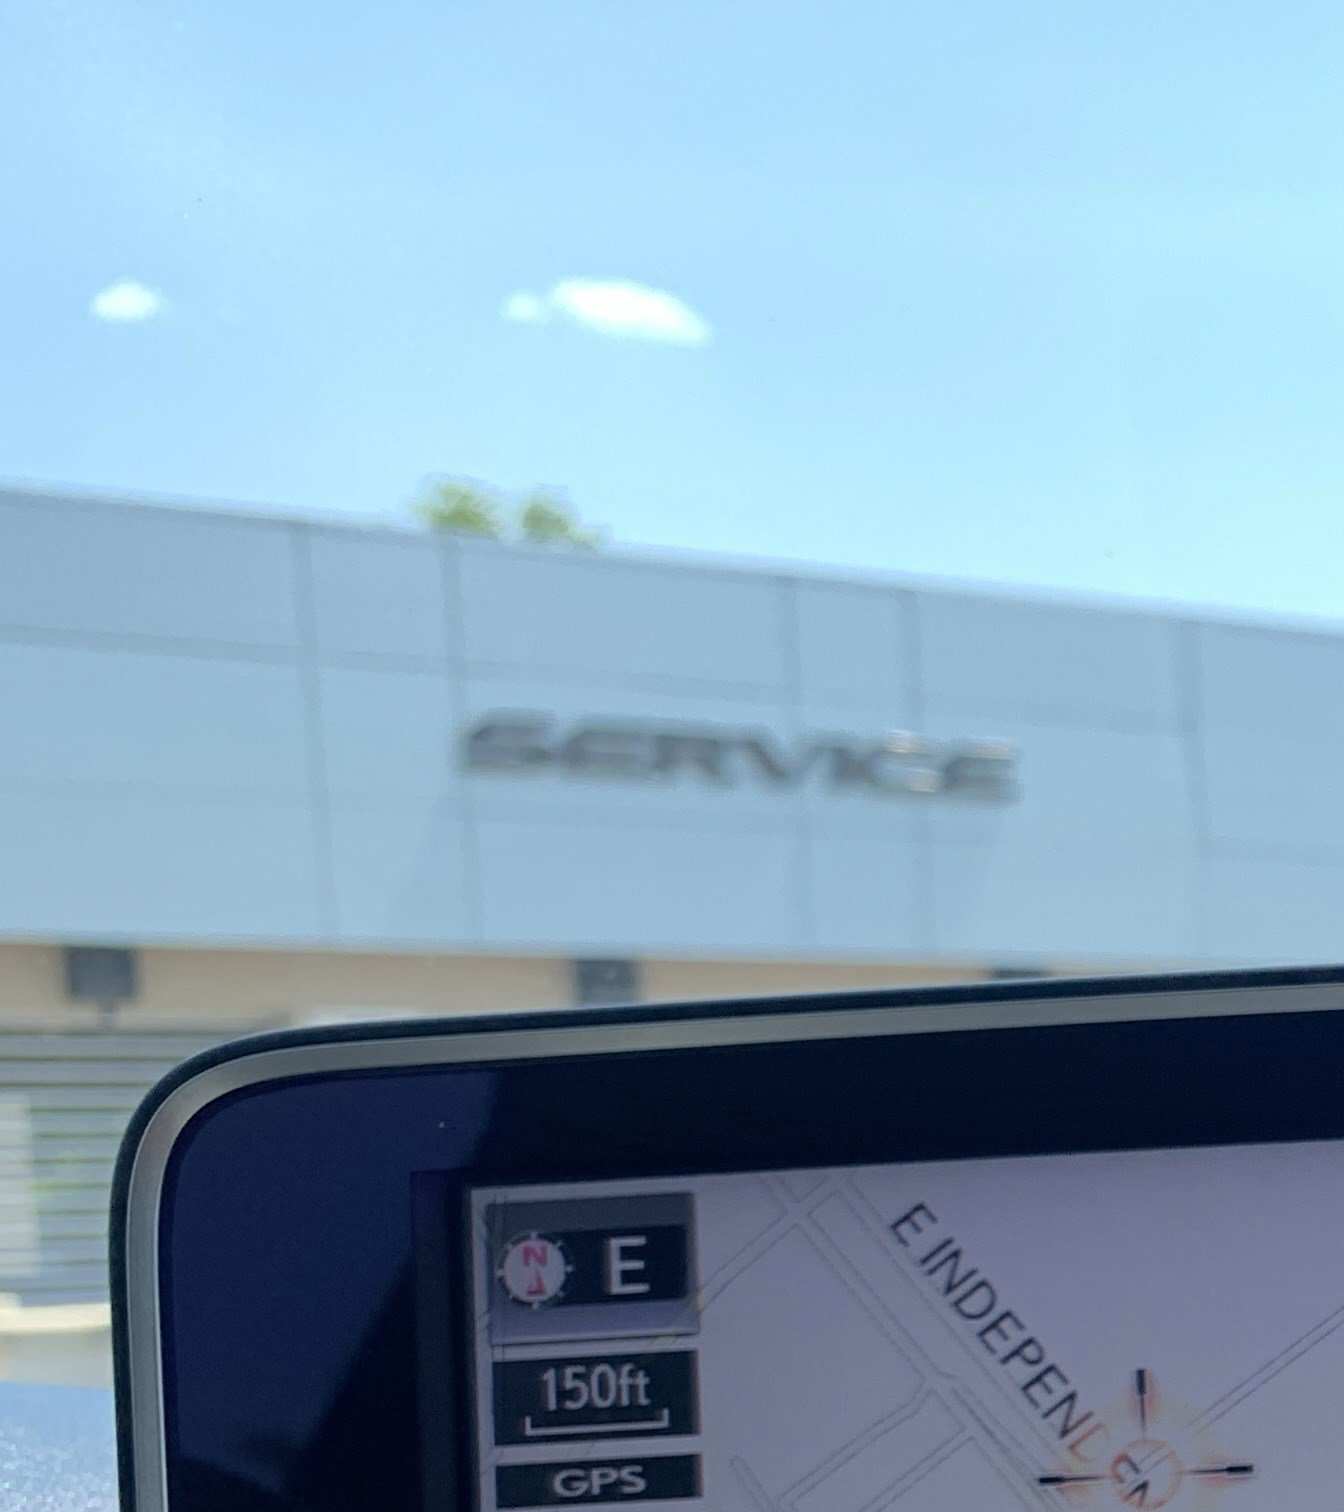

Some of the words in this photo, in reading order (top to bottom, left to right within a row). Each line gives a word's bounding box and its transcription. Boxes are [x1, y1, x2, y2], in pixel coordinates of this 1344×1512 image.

[463, 708, 1020, 805] SERVICE
[890, 1202, 938, 1247] E
[609, 1235, 650, 1295] E
[540, 1361, 651, 1413] 150ft
[551, 1465, 647, 1497] GPS
